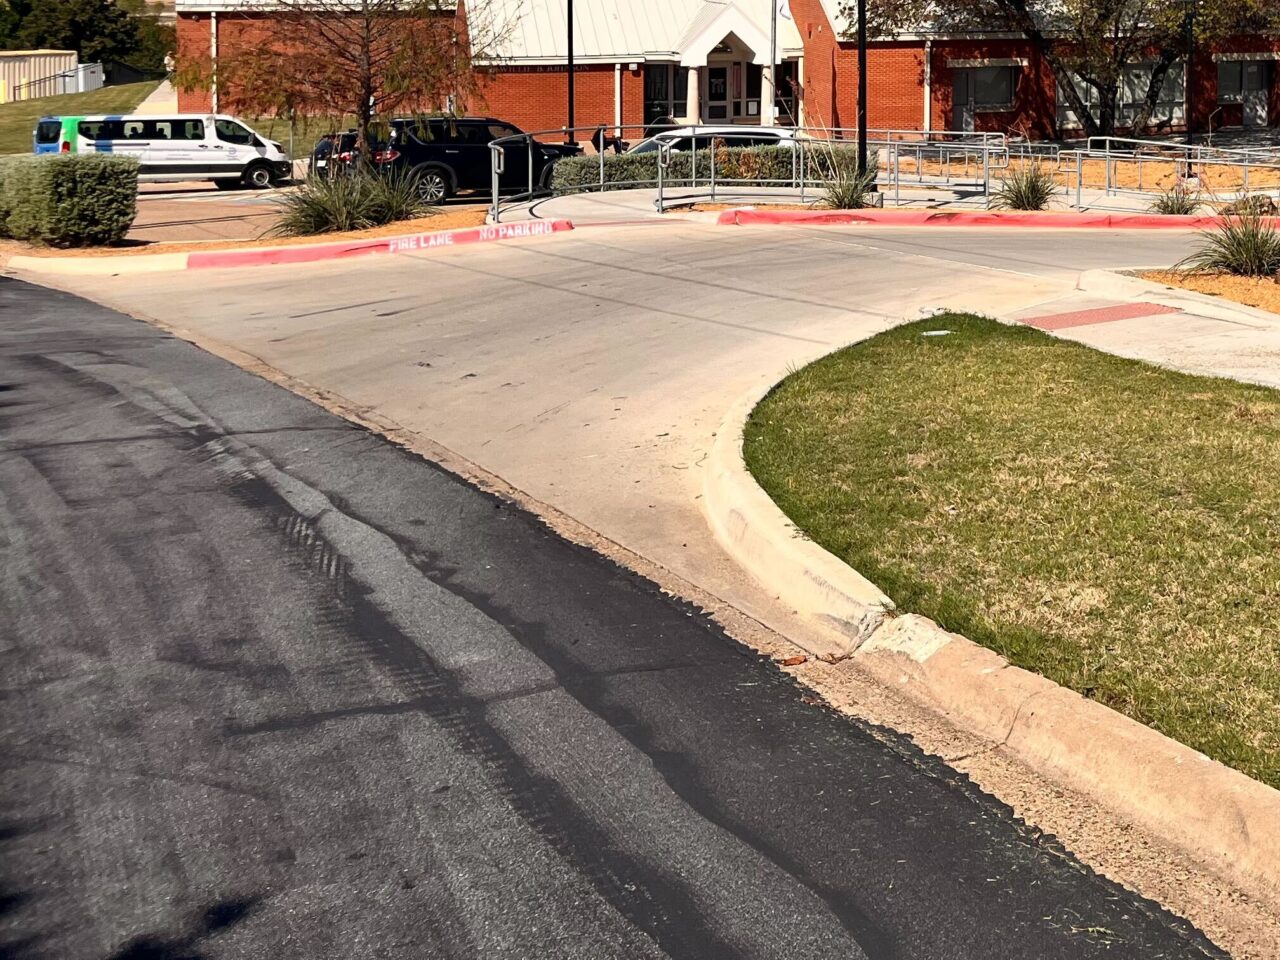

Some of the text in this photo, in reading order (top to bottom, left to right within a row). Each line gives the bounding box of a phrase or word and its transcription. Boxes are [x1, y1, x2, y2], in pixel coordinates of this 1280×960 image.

[389, 223, 552, 252] FIRE LANE NO PARKING
